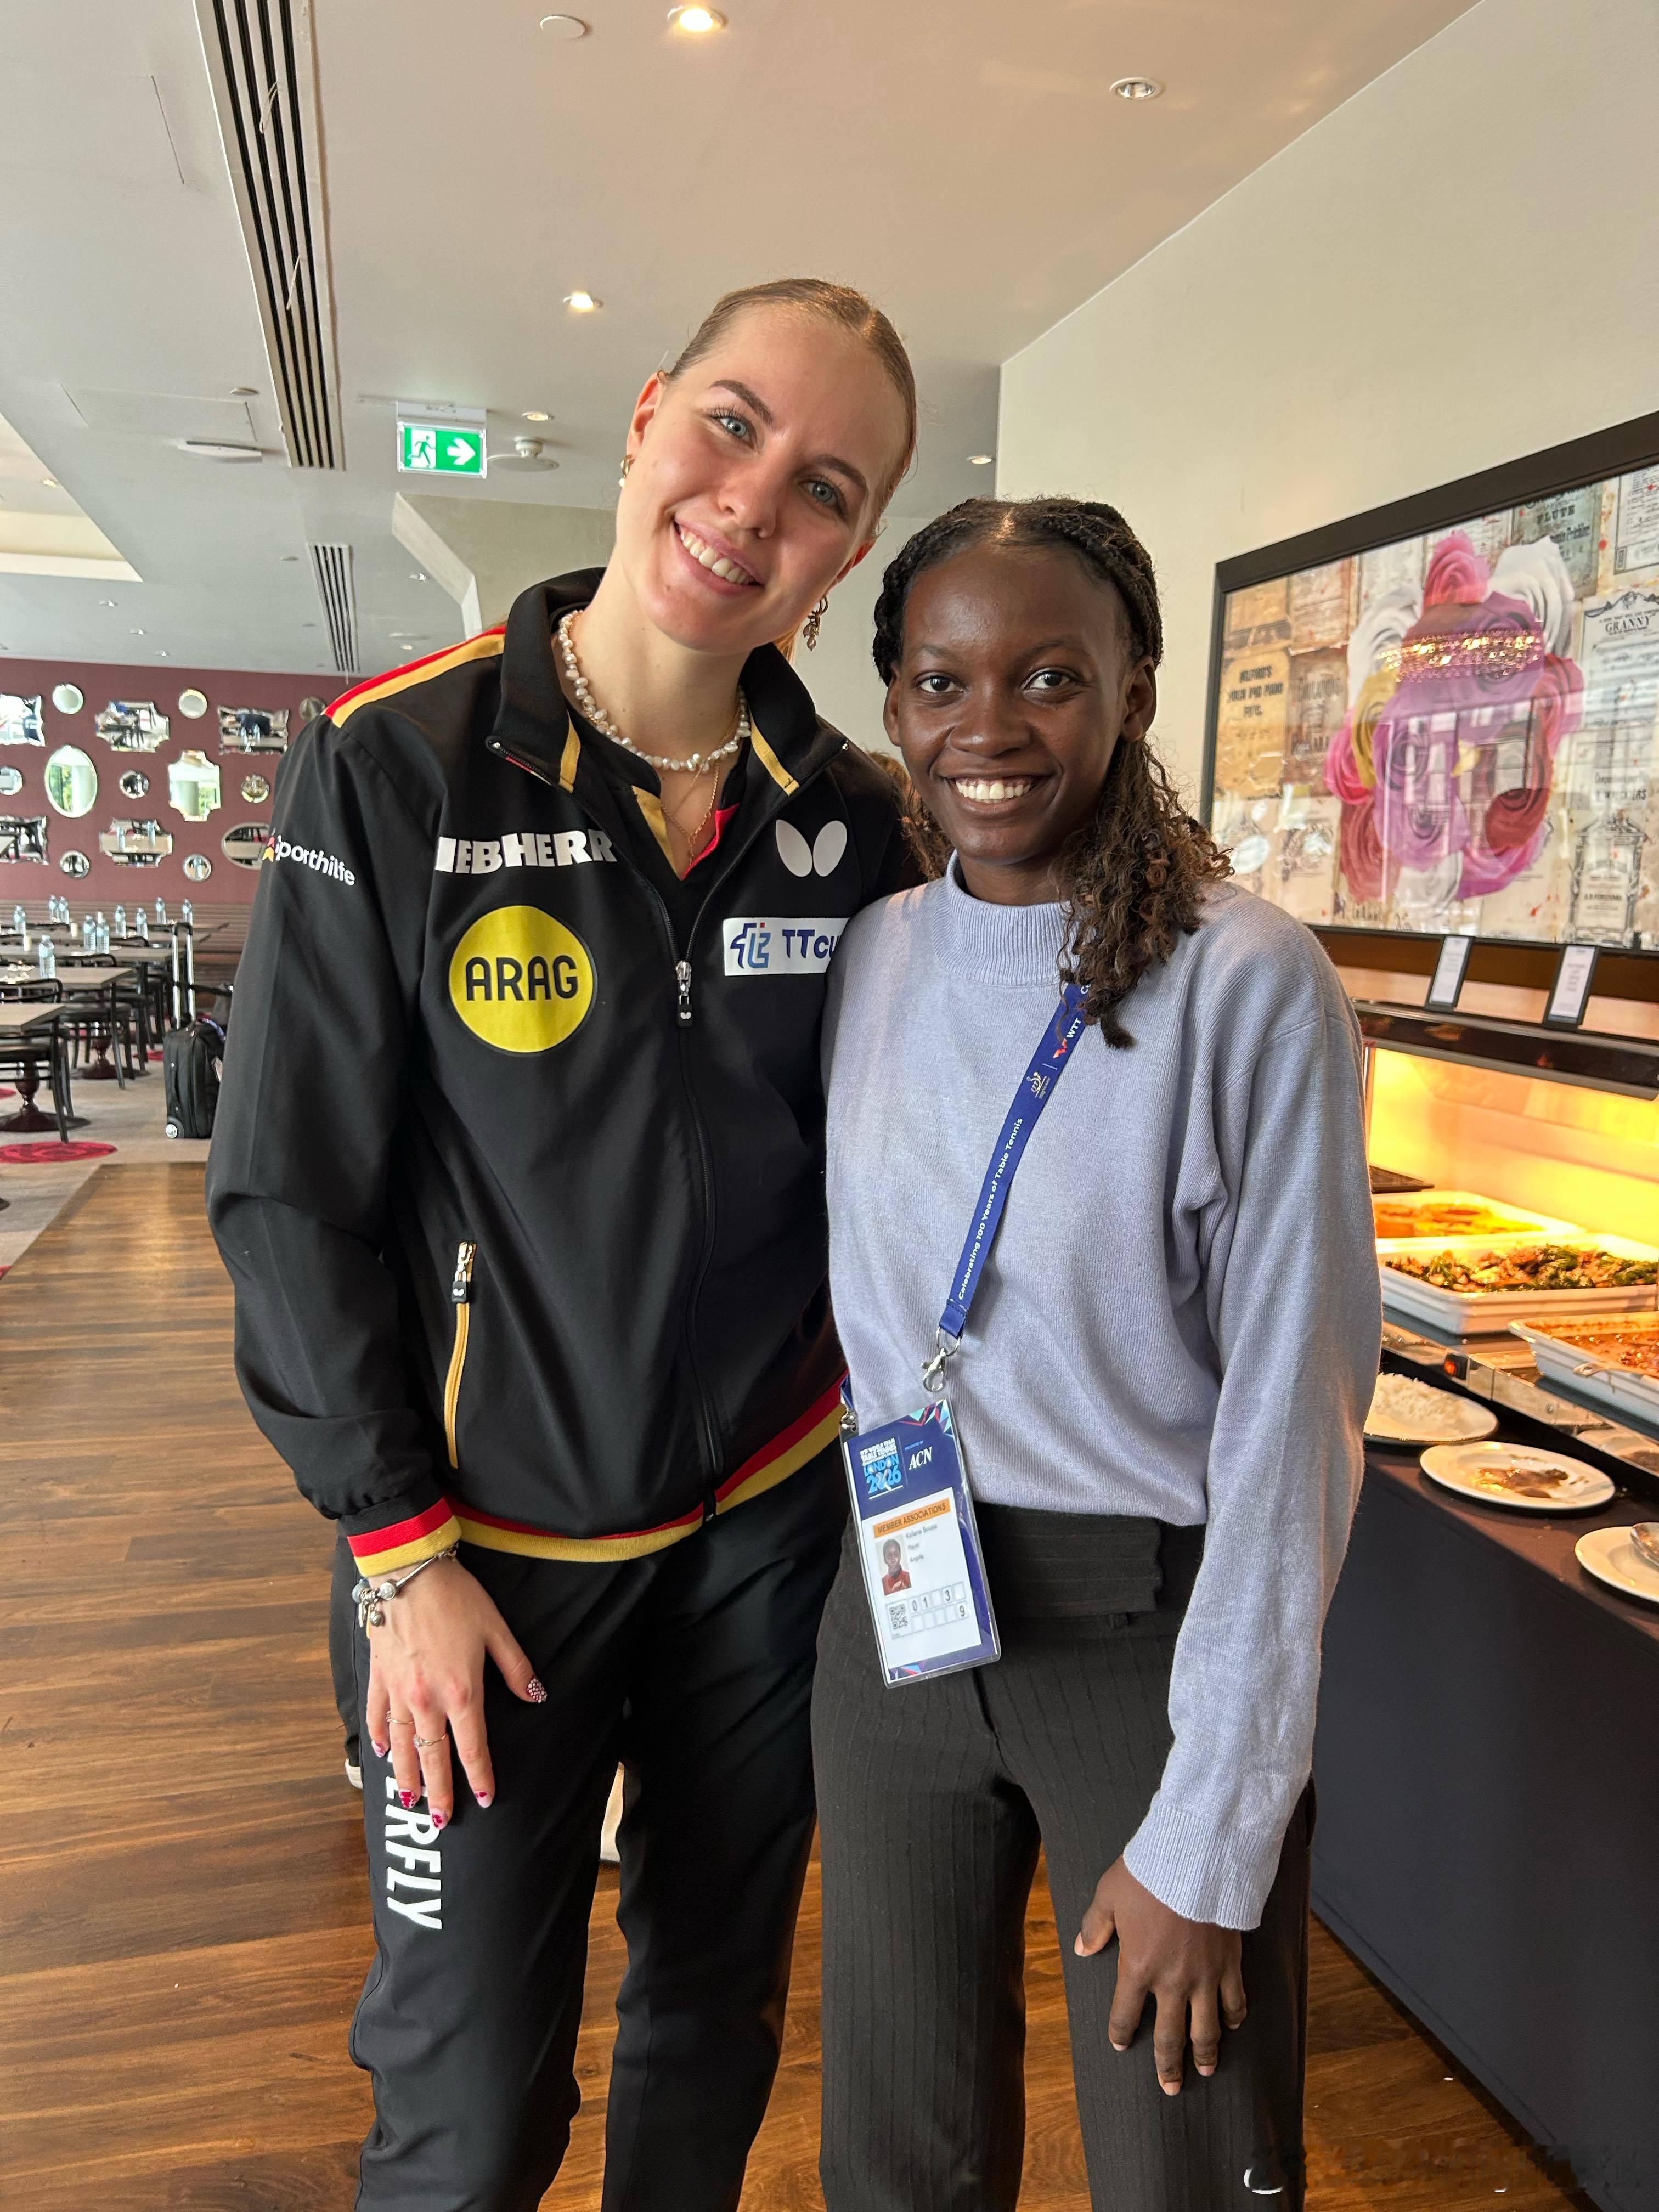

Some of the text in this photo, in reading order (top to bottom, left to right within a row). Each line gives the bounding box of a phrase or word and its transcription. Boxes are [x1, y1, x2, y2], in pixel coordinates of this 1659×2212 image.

[435, 830, 618, 874] IEBHERR
[465, 955, 579, 1001] ARAG
[1066, 1018, 1081, 1038] WTT
[958, 1118, 1023, 1300] Celebrating 100 Years of Table Tennis
[863, 1453, 899, 1477] LONDON
[909, 1446, 932, 1470] ACN
[866, 1464, 902, 1493] 2026
[878, 1503, 946, 1533] MEMBER ASSOCIATIONS
[923, 1597, 928, 1609] 1
[945, 1590, 951, 1601] 3
[960, 1605, 965, 1617] 9
[385, 1750, 442, 1930] RFLY
